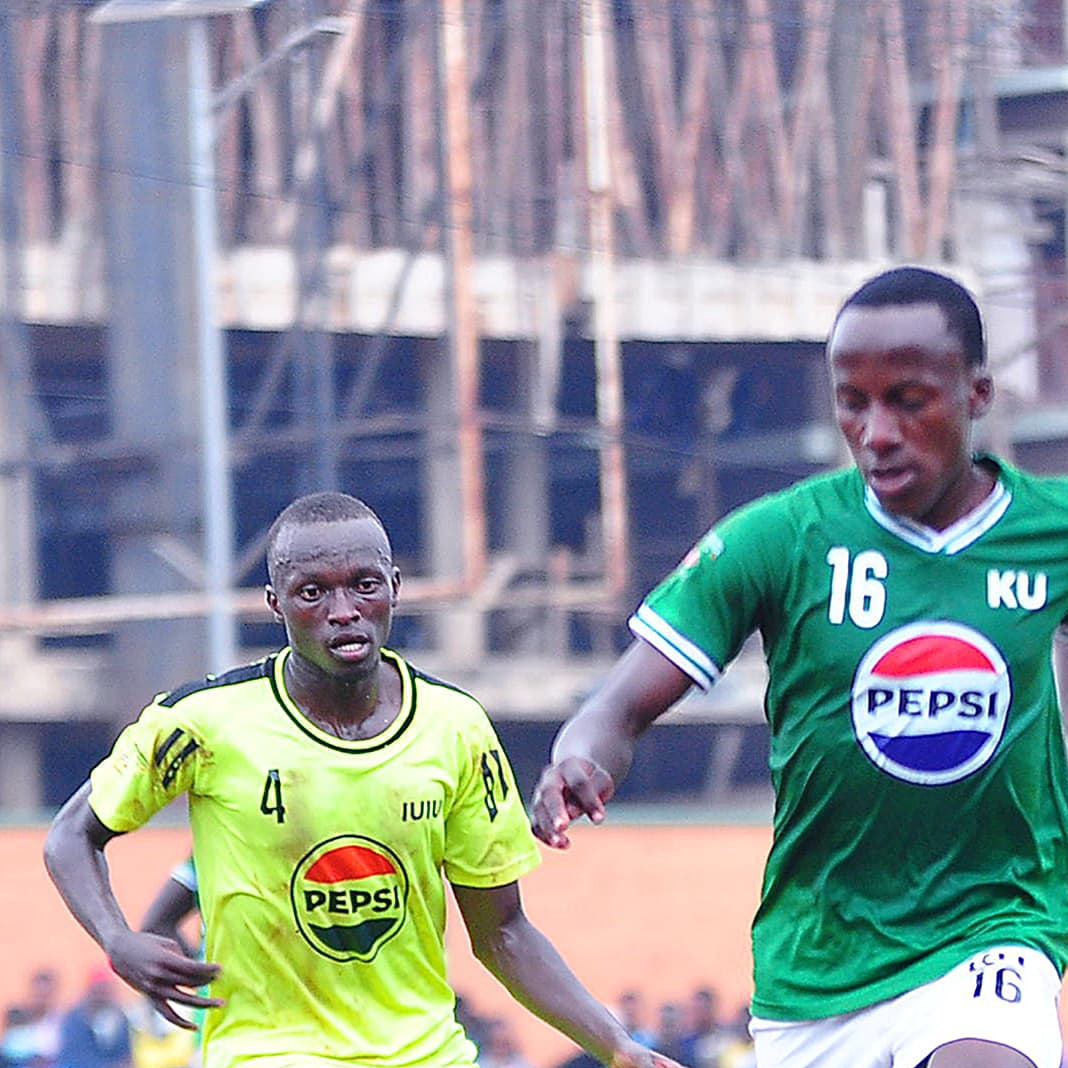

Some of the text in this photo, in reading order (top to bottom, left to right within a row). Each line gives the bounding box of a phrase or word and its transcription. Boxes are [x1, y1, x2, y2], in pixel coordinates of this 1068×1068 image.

[826, 546, 888, 629] 16
[985, 568, 1048, 611] KU
[867, 688, 998, 718] PEPSI
[260, 769, 286, 824] 4
[303, 885, 401, 914] PEPSI
[973, 968, 1022, 1004] 16
